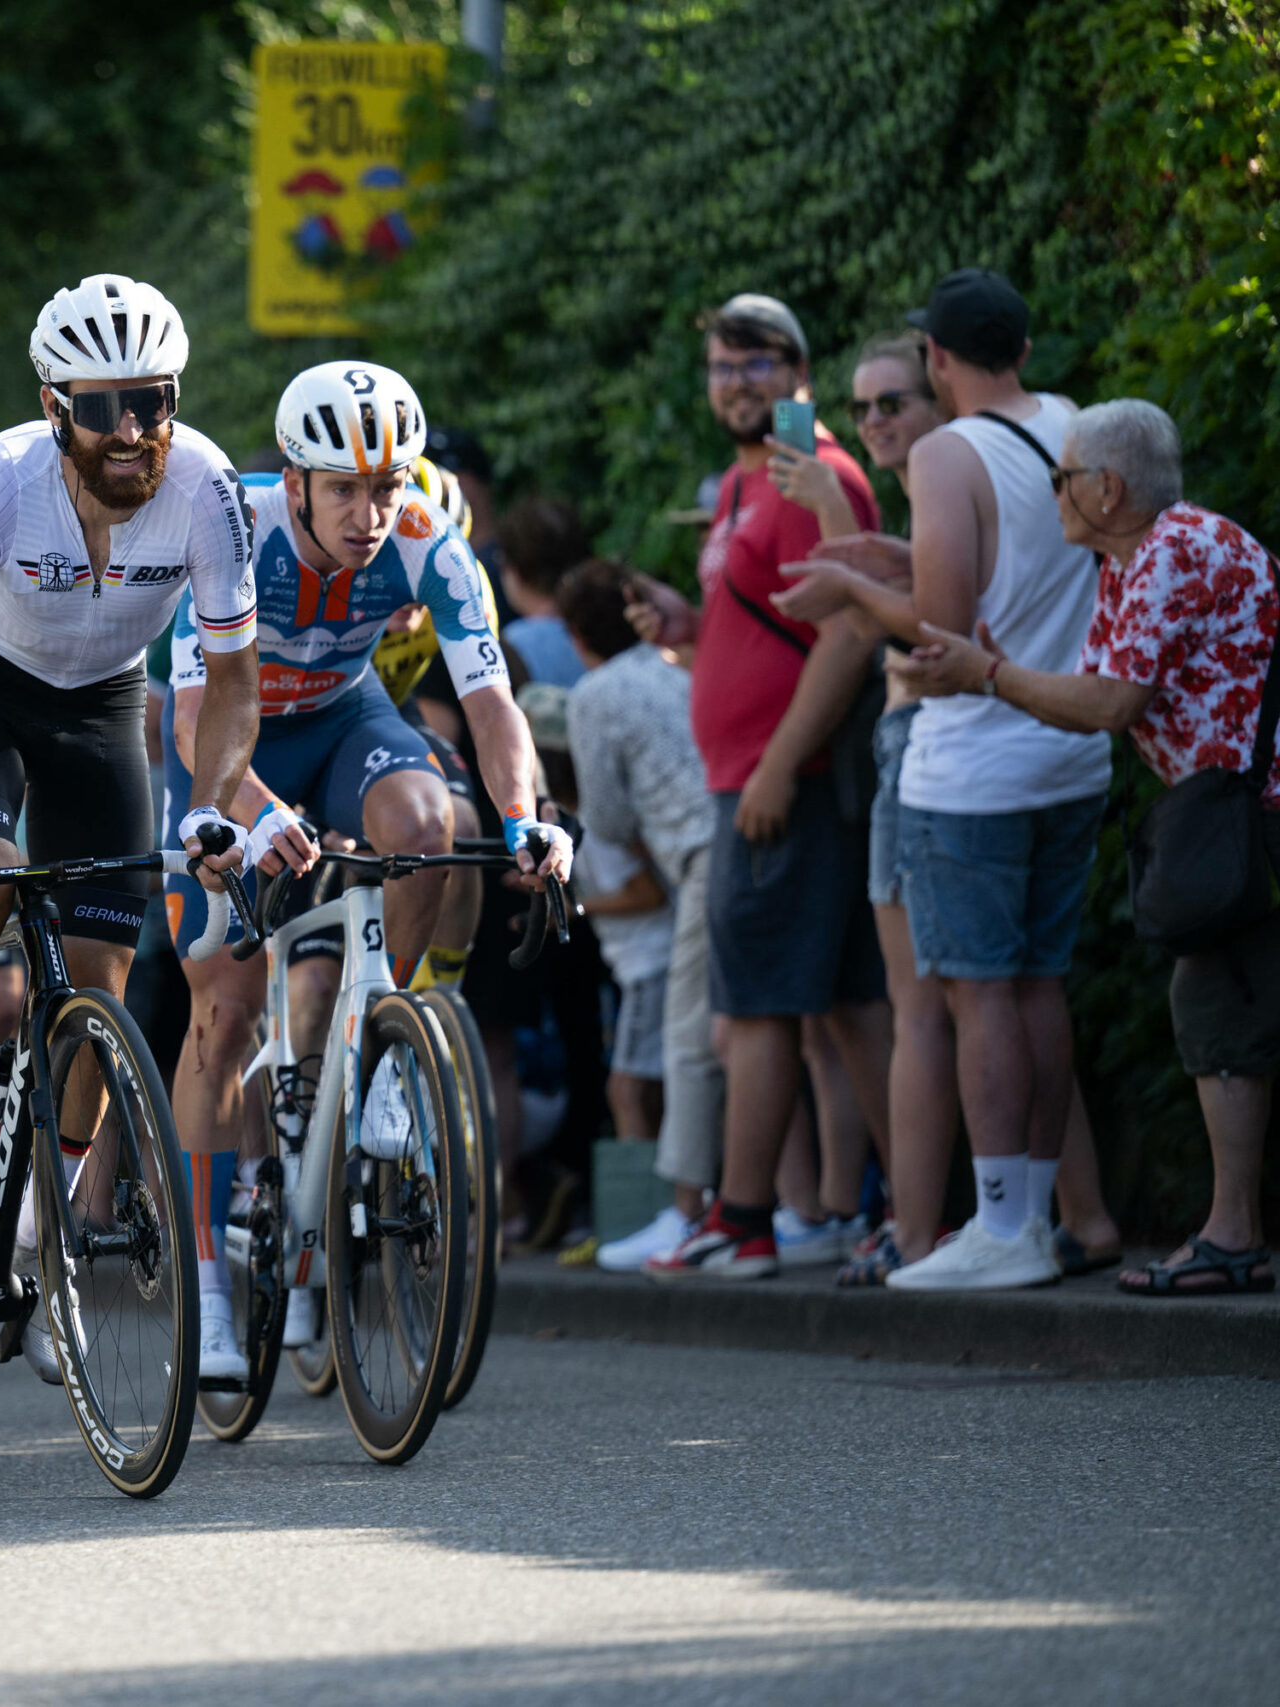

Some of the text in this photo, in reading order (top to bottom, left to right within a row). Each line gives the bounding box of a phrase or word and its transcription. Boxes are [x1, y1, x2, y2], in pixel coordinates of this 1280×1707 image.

[211, 479, 232, 503] BIKE
[225, 506, 243, 563] INDUSTRIES
[131, 565, 185, 582] BDR
[73, 904, 144, 929] GERMANY
[46, 931, 63, 981] LOOK
[50, 1291, 125, 1471] CORIMA
